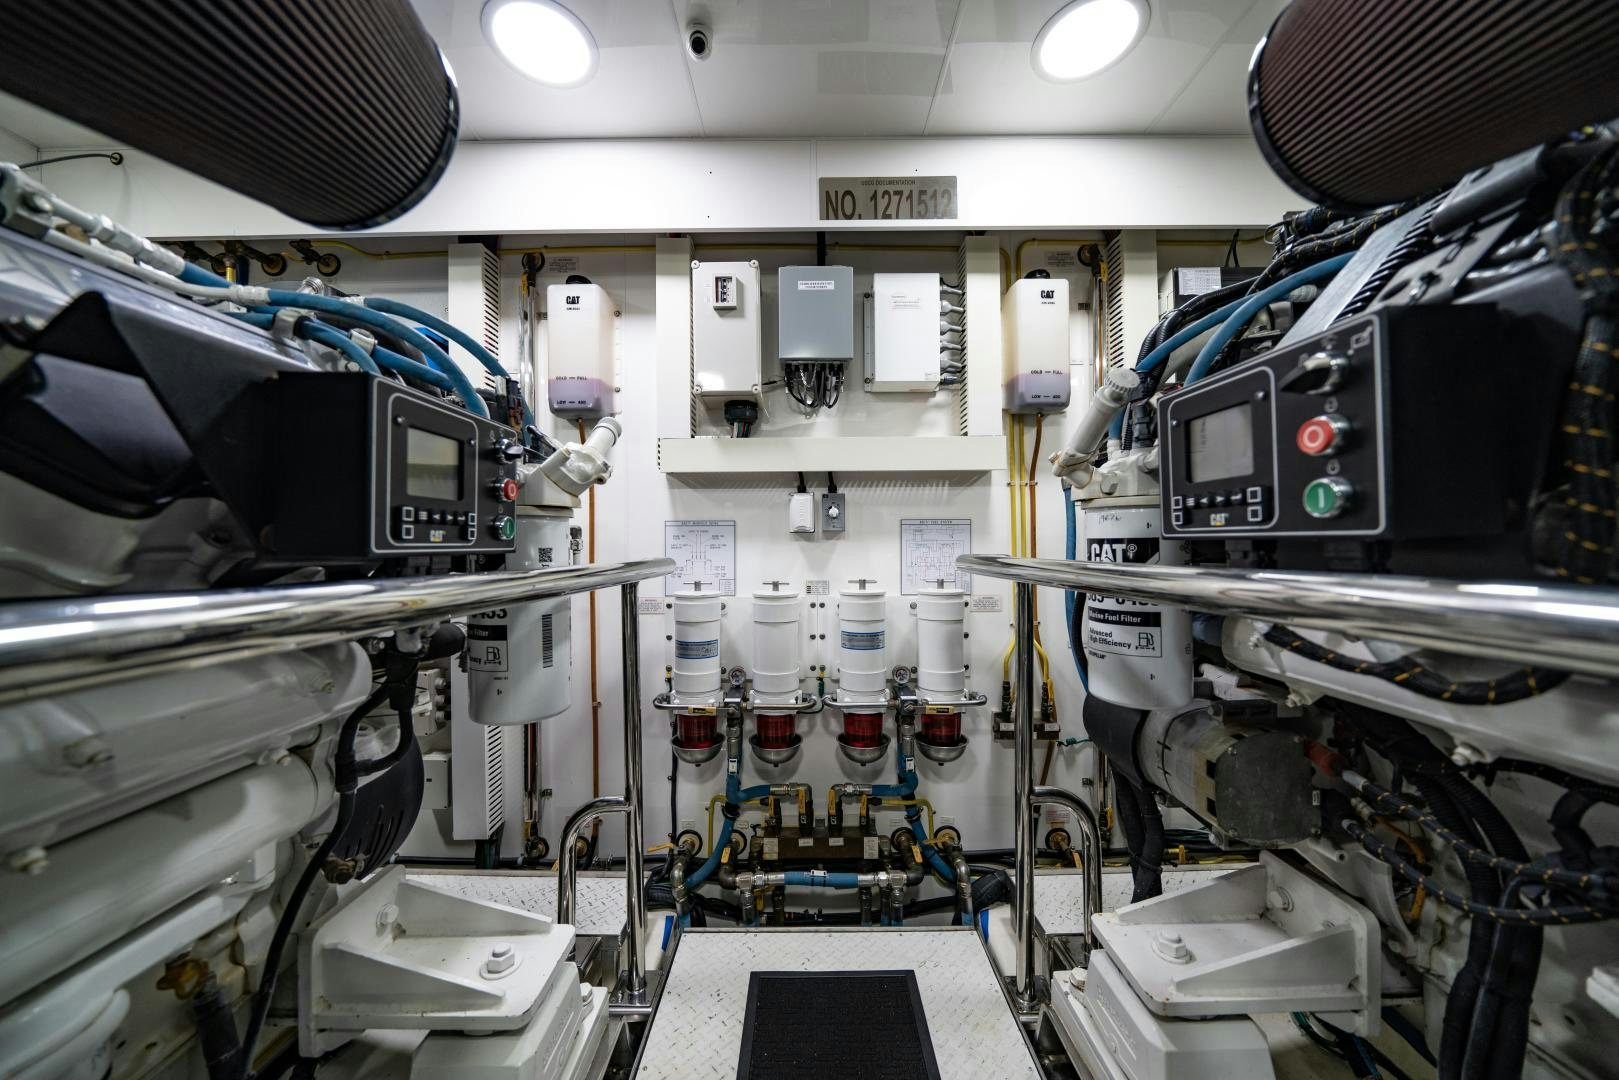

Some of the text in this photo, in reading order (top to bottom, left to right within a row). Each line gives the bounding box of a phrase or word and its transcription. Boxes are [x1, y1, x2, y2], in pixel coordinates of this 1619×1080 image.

[825, 188, 952, 220] NO. 1271512
[1041, 290, 1054, 298] CAT
[566, 296, 580, 304] CAT
[1105, 612, 1119, 621] Fuel
[1120, 614, 1142, 623] Filter
[1089, 627, 1113, 638] Advanced
[1098, 638, 1132, 650] Efficiency
